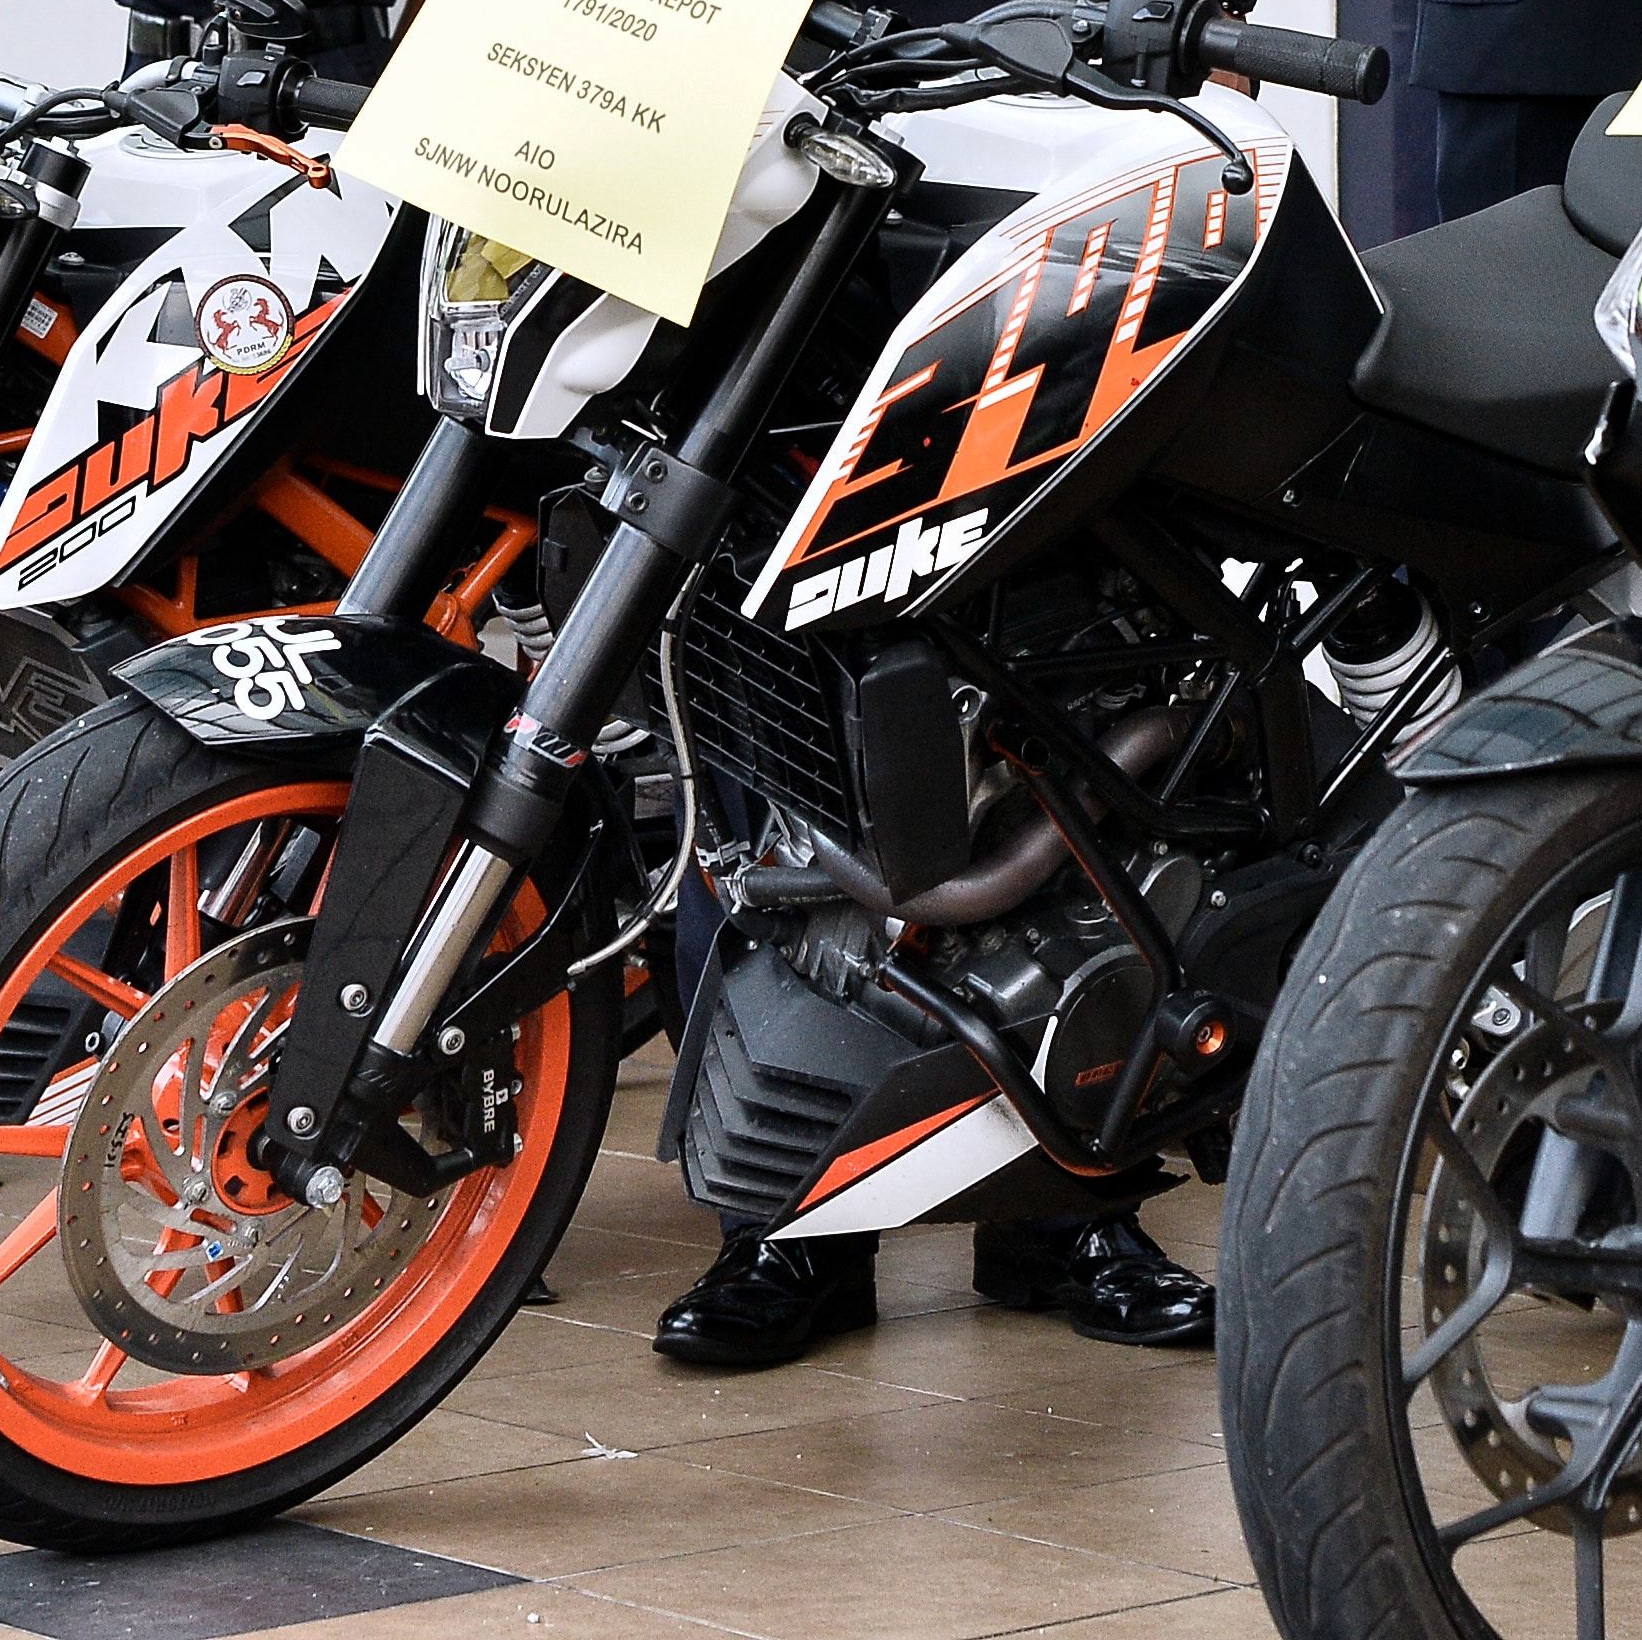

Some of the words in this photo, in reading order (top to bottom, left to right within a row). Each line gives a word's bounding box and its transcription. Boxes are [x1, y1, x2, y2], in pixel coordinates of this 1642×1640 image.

[487, 42, 577, 94] SEKSYEN
[575, 79, 627, 119] 379A
[631, 102, 668, 135] KK
[414, 136, 478, 179] SJN/W
[477, 164, 643, 256] NOORULAZIRA
[514, 139, 556, 171] AIO
[17, 496, 138, 592] 200
[785, 507, 989, 632] DUKE
[483, 1069, 495, 1134] BYBRE
